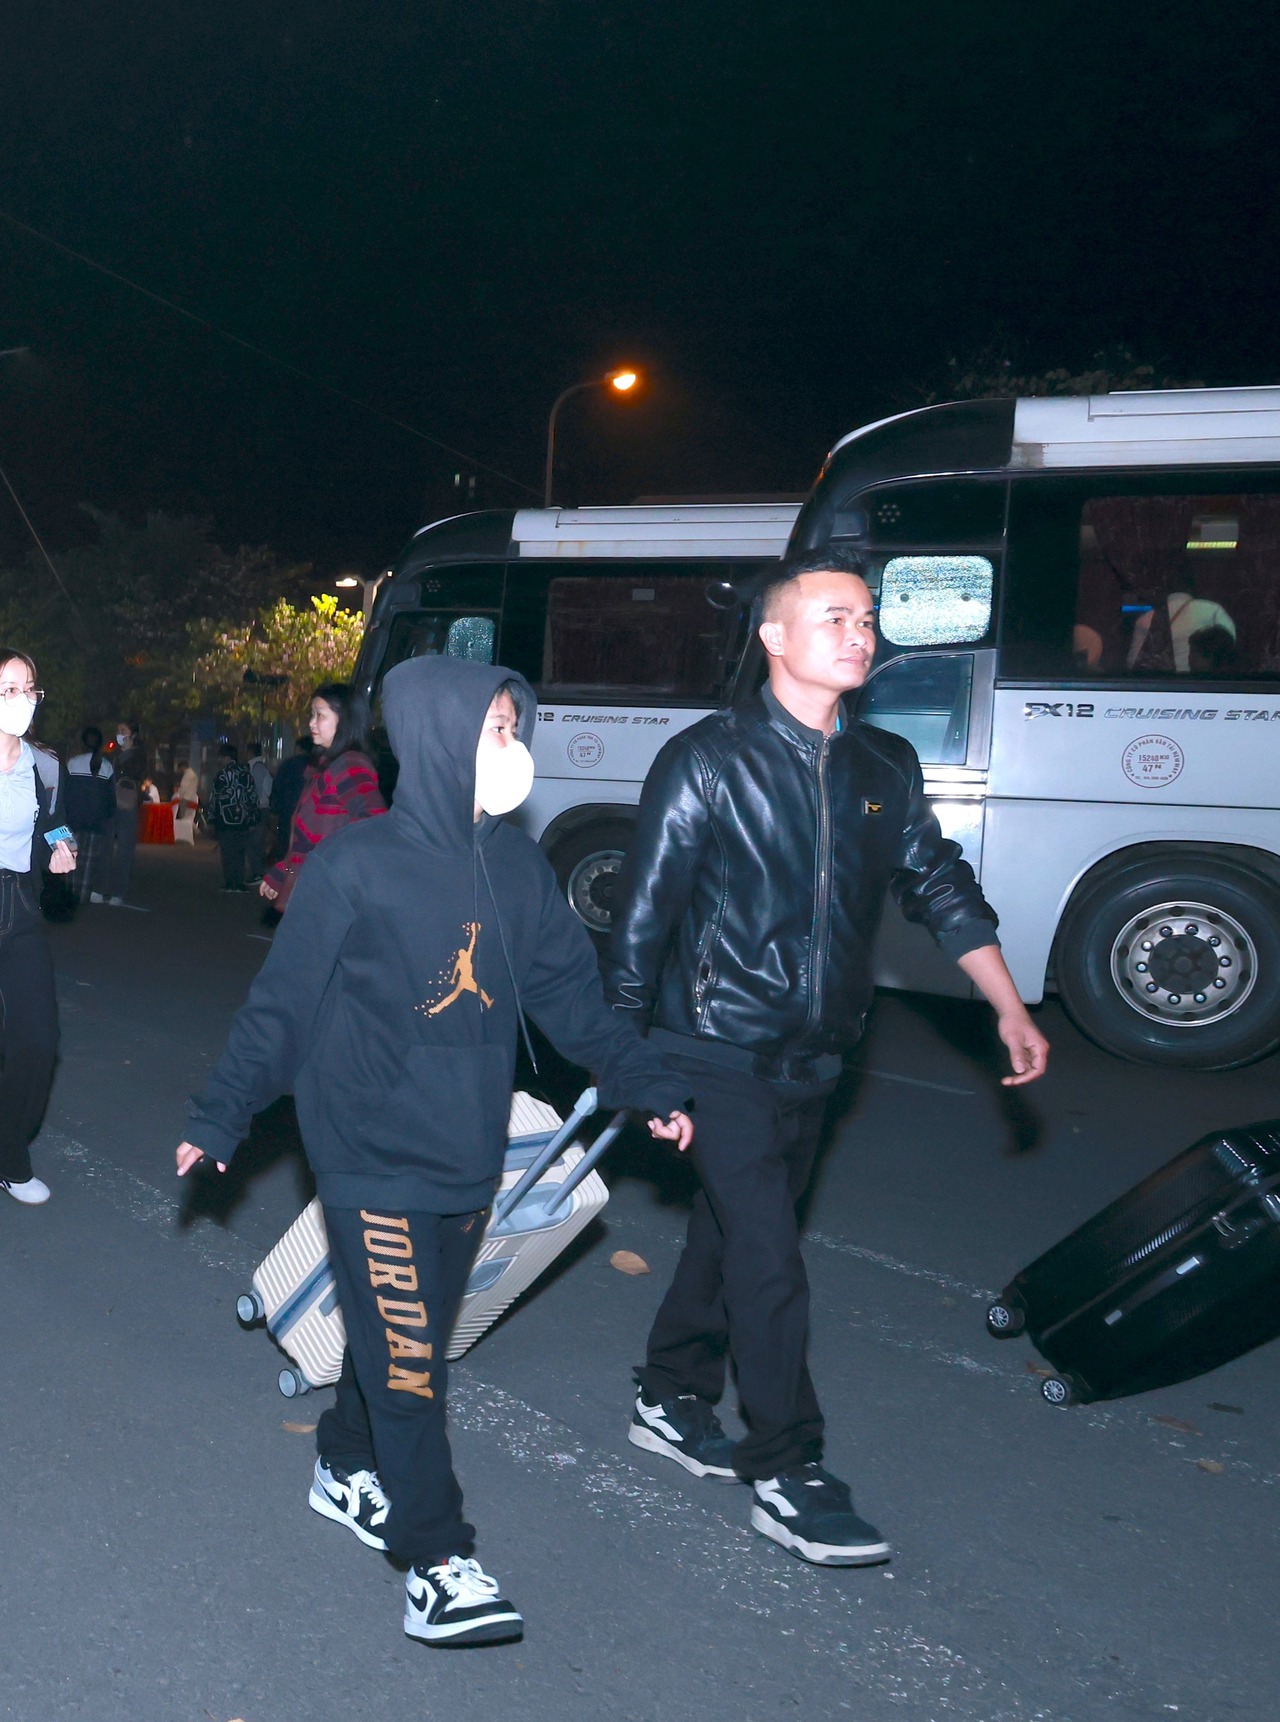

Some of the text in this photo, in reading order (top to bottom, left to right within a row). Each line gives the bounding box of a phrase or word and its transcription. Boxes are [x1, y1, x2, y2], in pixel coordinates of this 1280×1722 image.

[537, 712, 670, 725] 12 CRUISING STAR
[1104, 708, 1218, 720] CRUISING
[1142, 764, 1153, 772] 47
[360, 1209, 434, 1399] JORDAN
